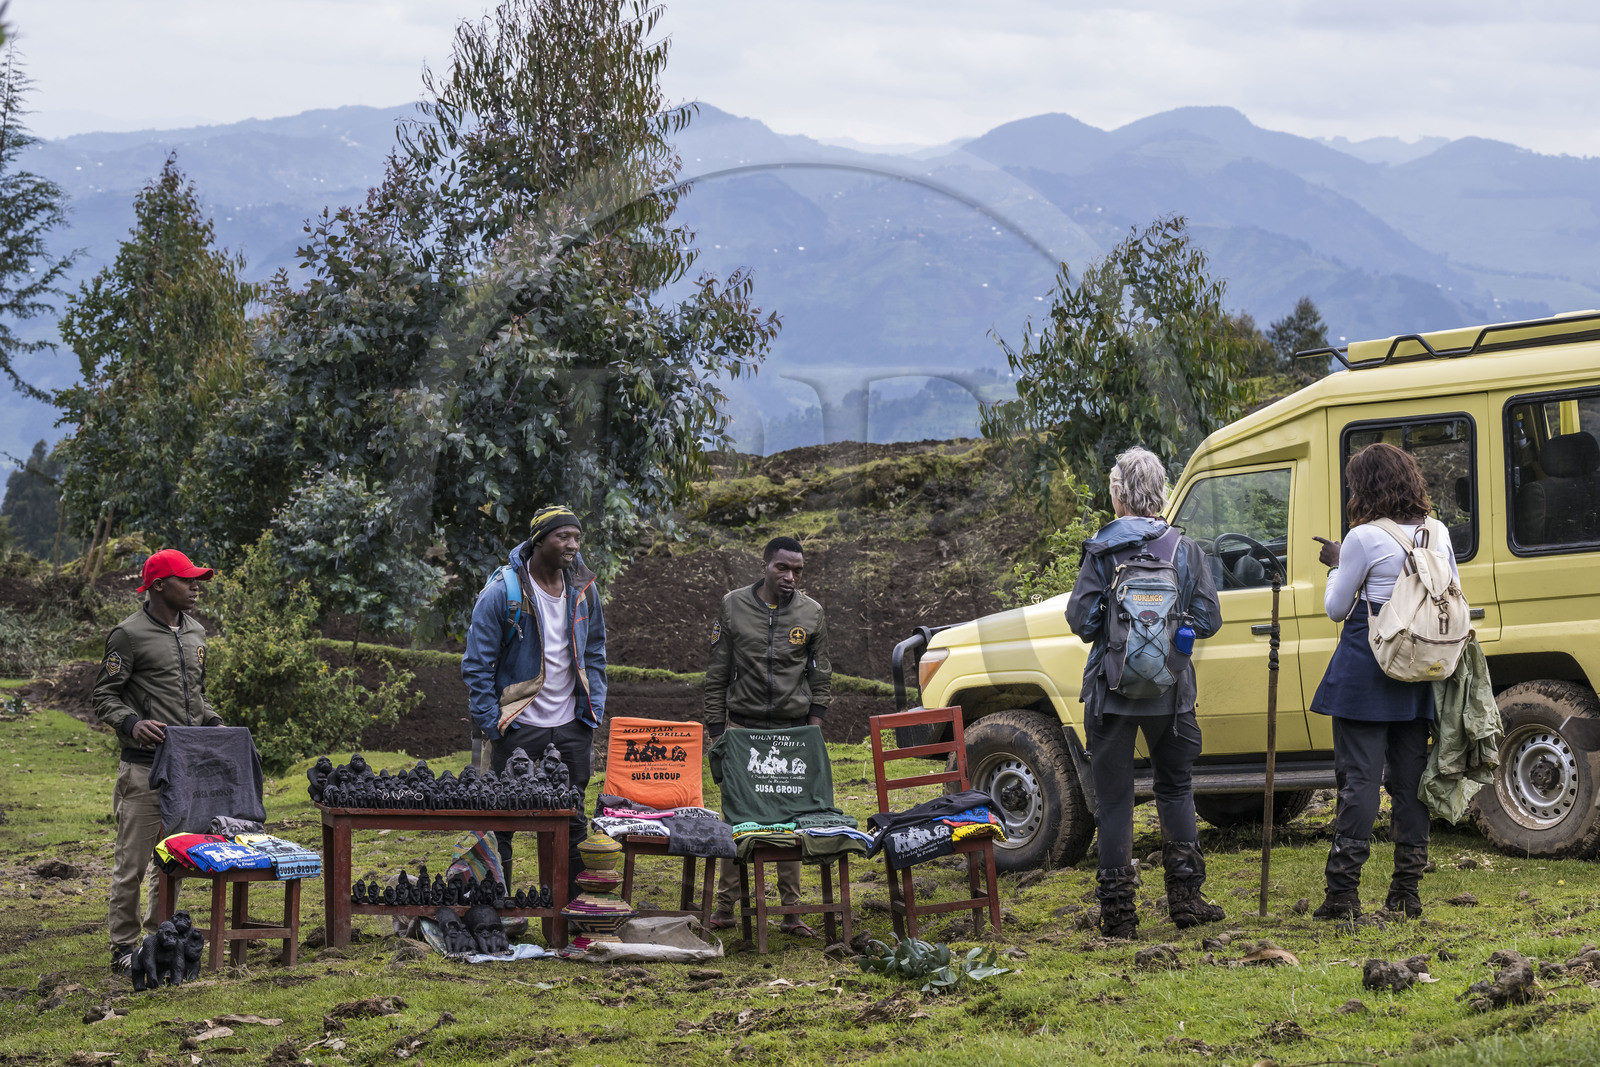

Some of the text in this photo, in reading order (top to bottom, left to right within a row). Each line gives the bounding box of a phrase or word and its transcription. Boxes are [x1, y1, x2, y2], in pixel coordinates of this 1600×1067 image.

[1132, 594, 1163, 602] DURANGO
[623, 726, 675, 734] MOUNTAIN
[631, 772, 681, 780] SUSA GROUP
[210, 788, 235, 798] GROUP
[755, 784, 803, 794] SUSA GROUP
[280, 864, 319, 875] SUSA GROUP
